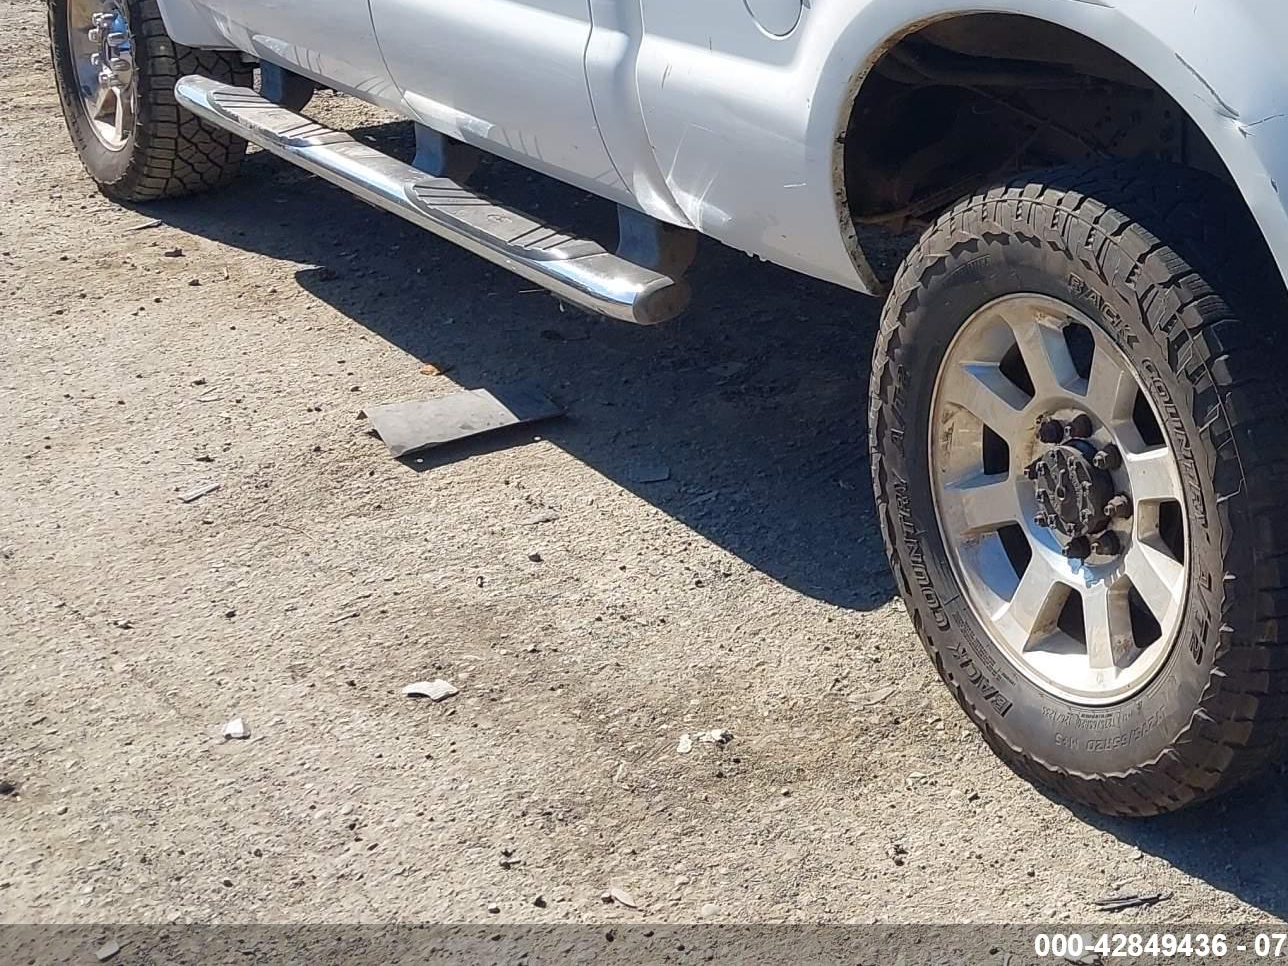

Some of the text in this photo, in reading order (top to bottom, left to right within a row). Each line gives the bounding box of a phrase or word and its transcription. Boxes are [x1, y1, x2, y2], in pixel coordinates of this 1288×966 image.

[1067, 272, 1141, 351] BACK
[1140, 357, 1211, 545] COUNTRY
[891, 467, 951, 632] COUNTRY
[946, 641, 1013, 720] BACK
